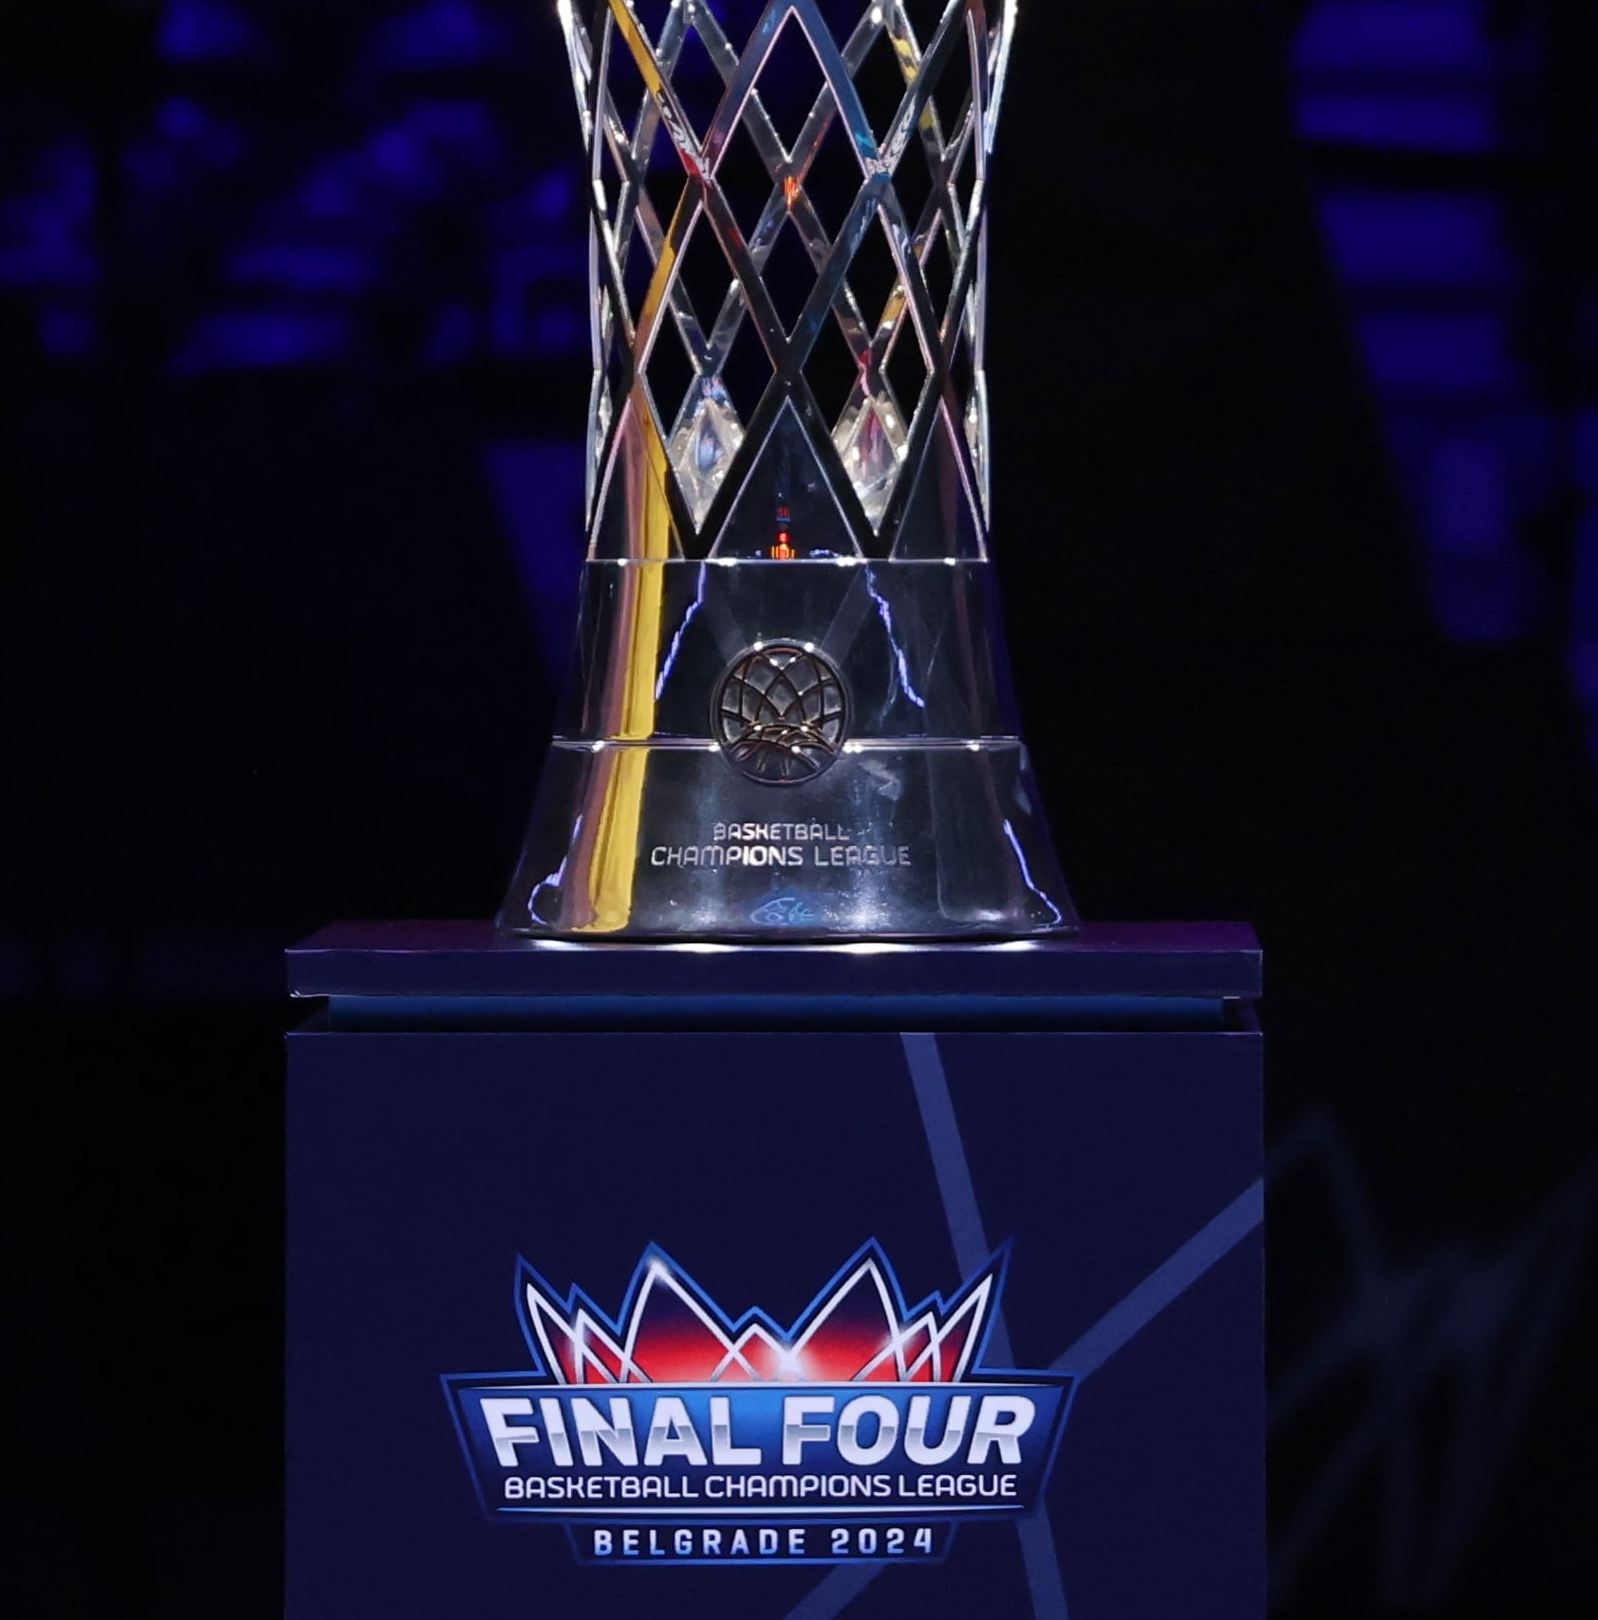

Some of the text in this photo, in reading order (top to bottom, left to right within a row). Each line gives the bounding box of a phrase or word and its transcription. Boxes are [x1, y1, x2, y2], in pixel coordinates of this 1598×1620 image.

[713, 821, 850, 841] BASKETBALL
[650, 845, 912, 868] CHAMPIONS LEAGUE
[478, 1394, 1037, 1467] FINAL FOUR
[504, 1473, 1018, 1500] BASKETBALL CHAMPIONS LEAGUE
[593, 1526, 934, 1557] BELGRADE 2024
